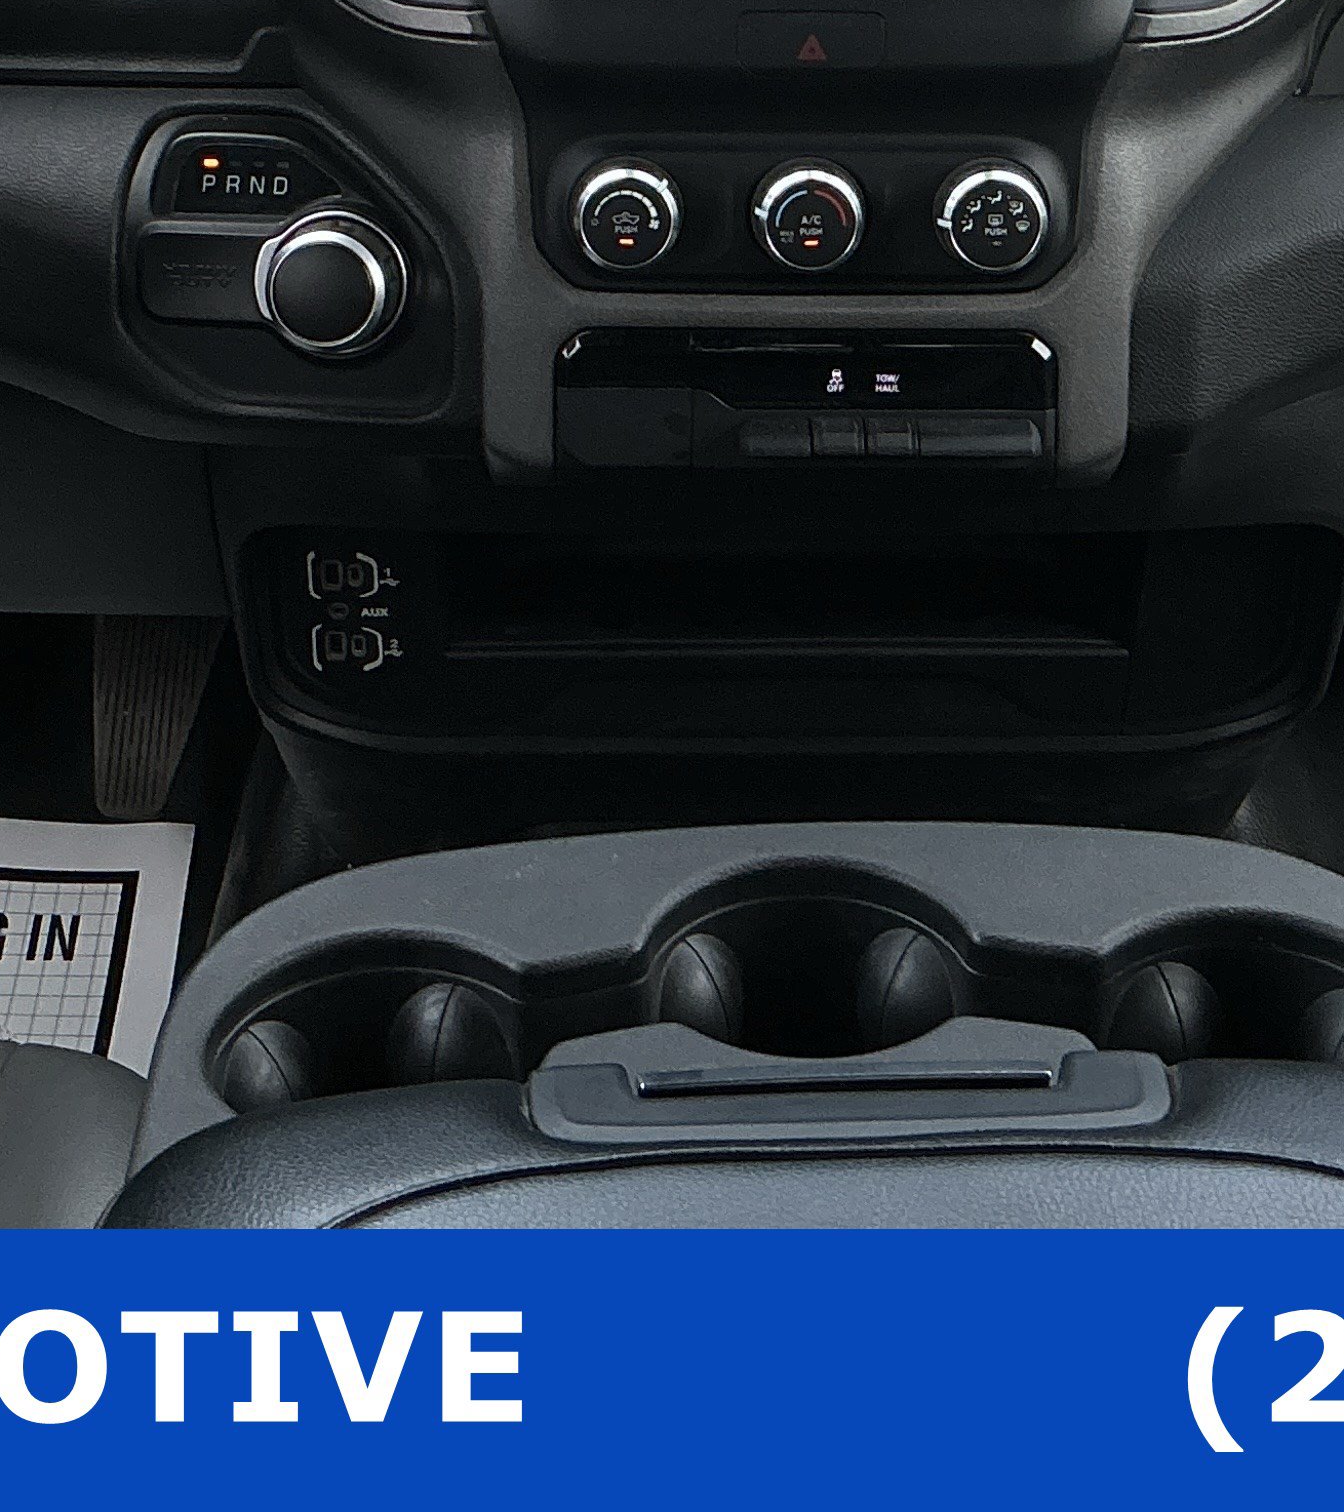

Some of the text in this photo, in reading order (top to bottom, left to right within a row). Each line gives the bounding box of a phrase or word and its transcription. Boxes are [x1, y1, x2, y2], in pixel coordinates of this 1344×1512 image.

[202, 174, 288, 196] P R N D
[800, 214, 823, 226] A/C
[614, 224, 640, 235] PUSH
[799, 227, 824, 237] PUSH
[984, 227, 1008, 237] PUSH
[875, 373, 901, 384] TOW/
[826, 383, 845, 393] OFF
[874, 384, 901, 393] HAUL
[360, 606, 389, 617] AUX
[25, 914, 83, 963] IN
